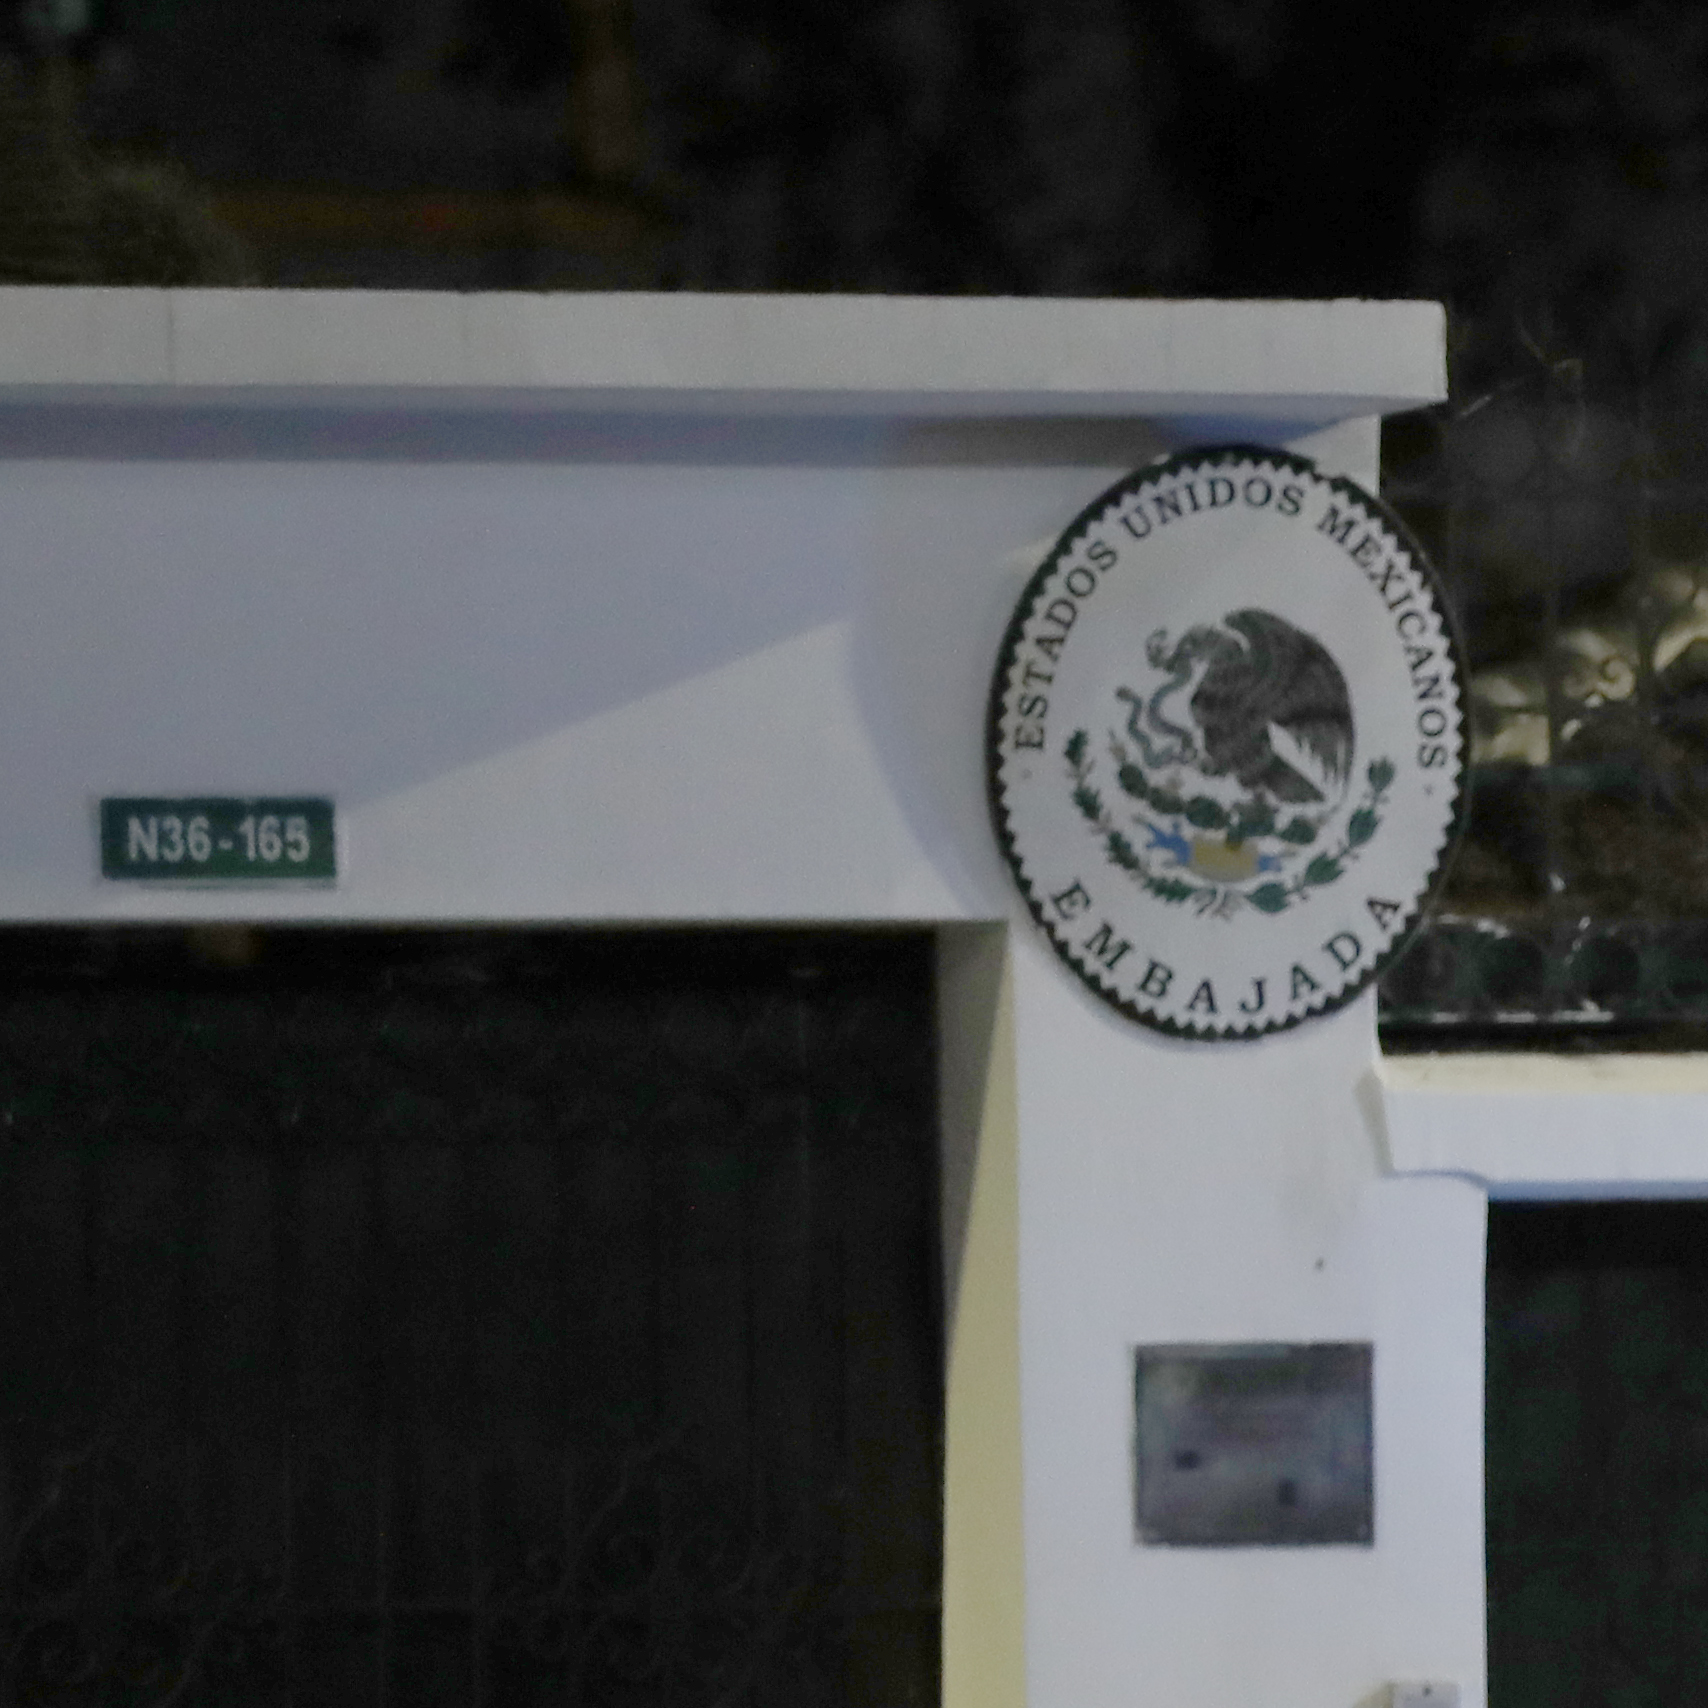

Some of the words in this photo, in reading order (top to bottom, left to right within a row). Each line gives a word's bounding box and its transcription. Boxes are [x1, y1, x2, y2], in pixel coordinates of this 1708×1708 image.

[1014, 542, 1119, 750] ESTADOS
[1122, 477, 1303, 540] UNIDOS
[1317, 506, 1447, 770] MEXICANOS
[1052, 880, 1400, 1013] EMBAJADA
